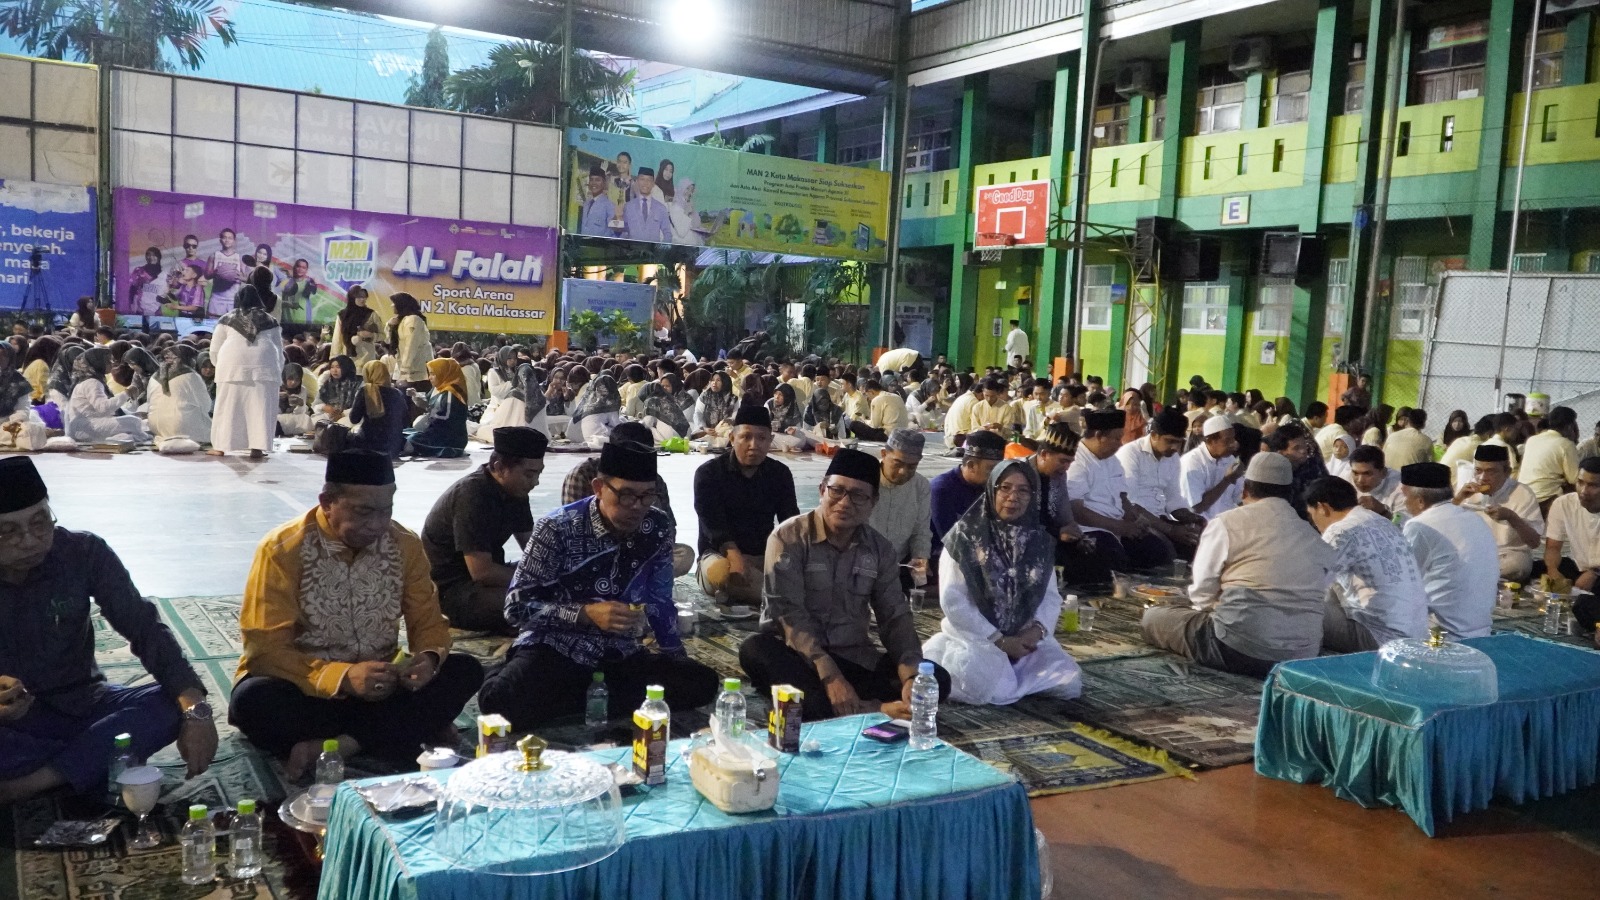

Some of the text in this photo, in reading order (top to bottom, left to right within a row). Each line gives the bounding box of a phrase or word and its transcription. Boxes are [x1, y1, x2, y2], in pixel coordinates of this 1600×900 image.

[746, 168, 763, 177] MAN
[787, 174, 817, 184] Makassar
[992, 188, 1015, 204] Good
[1016, 187, 1034, 204] Day
[1229, 201, 1241, 220] E
[11, 224, 75, 242] bekerja
[328, 241, 369, 260] M2M
[4, 258, 51, 270] maa
[326, 262, 371, 280] SPORT
[392, 245, 544, 284] Al- Falah
[433, 284, 514, 301] Sport Arena
[435, 302, 445, 314] 2
[448, 303, 480, 317] Kota
[482, 305, 545, 319] Makassar
